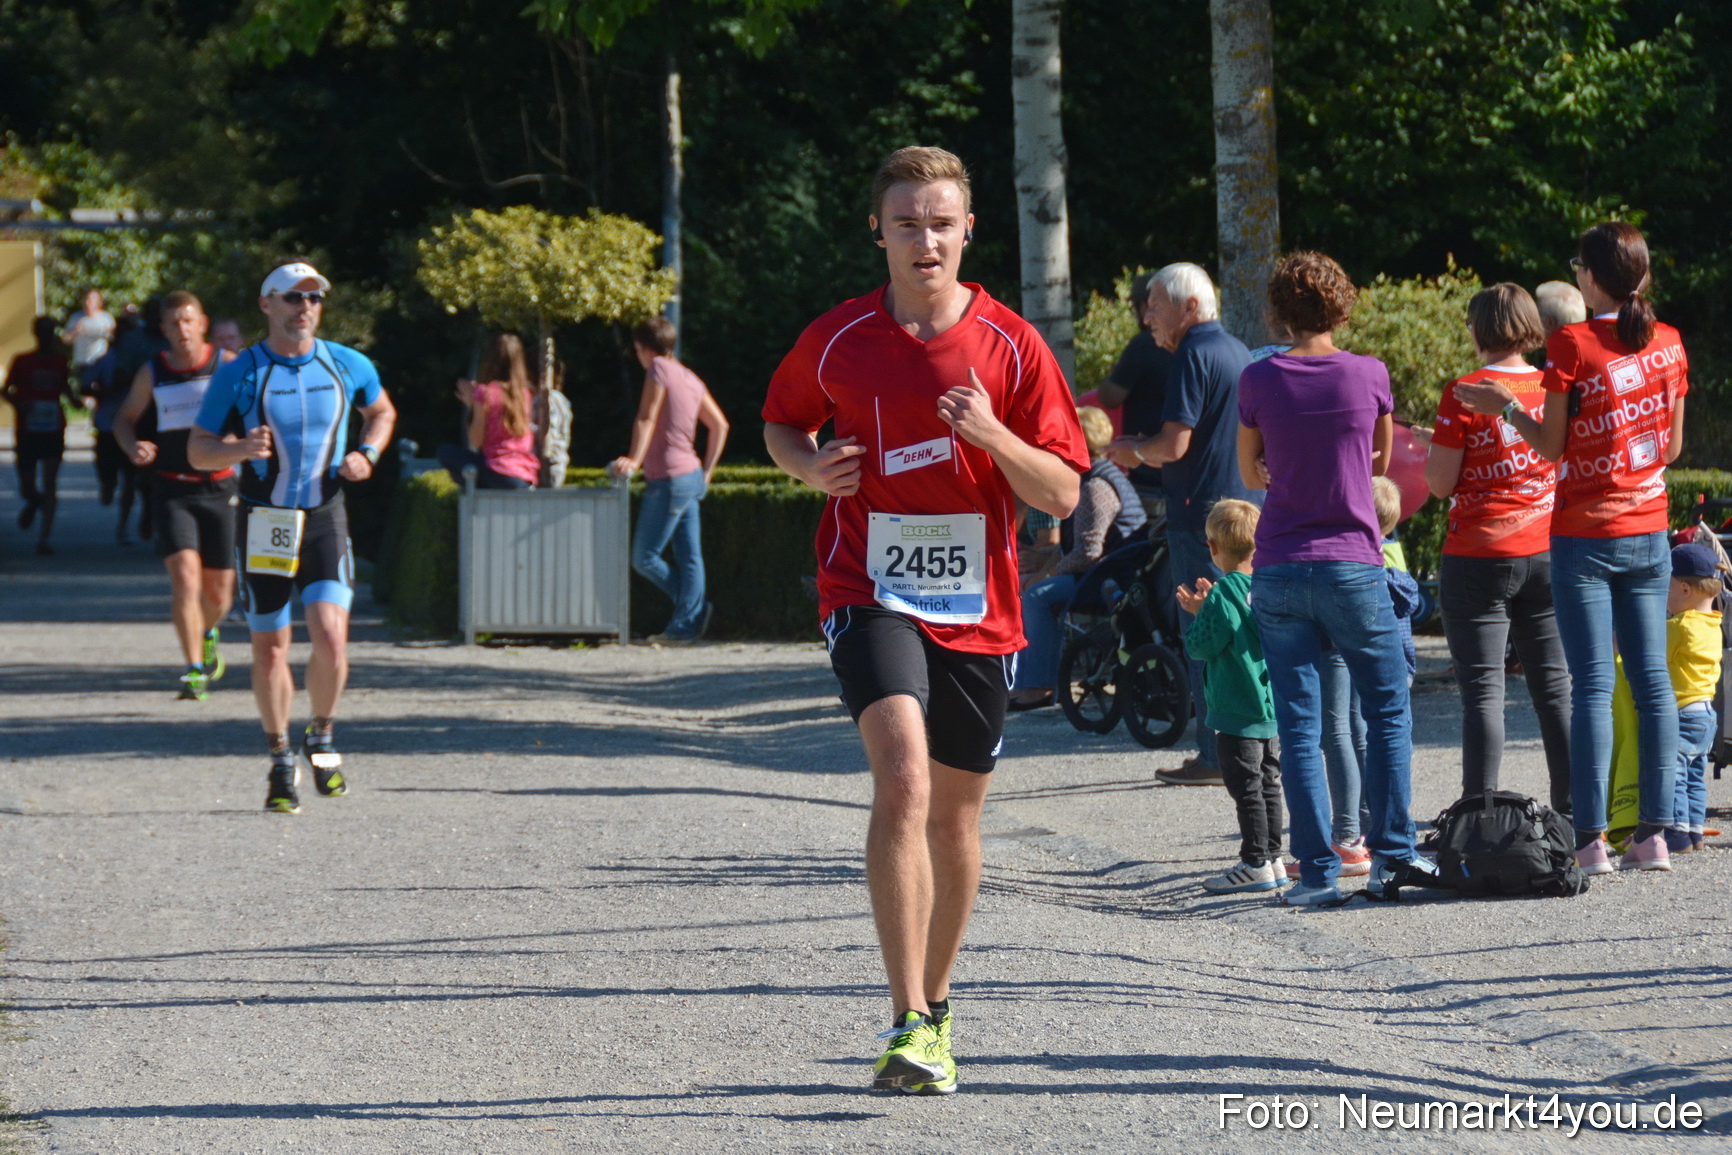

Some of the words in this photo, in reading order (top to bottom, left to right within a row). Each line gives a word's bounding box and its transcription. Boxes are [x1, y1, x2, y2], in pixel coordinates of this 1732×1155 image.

[1609, 357, 1636, 371] raumbox
[1571, 390, 1667, 438] aumbox
[903, 447, 933, 464] DEHN
[1462, 448, 1545, 480] aumbo
[271, 527, 290, 548] 85
[901, 525, 951, 536] BOCK
[885, 545, 967, 578] 2455
